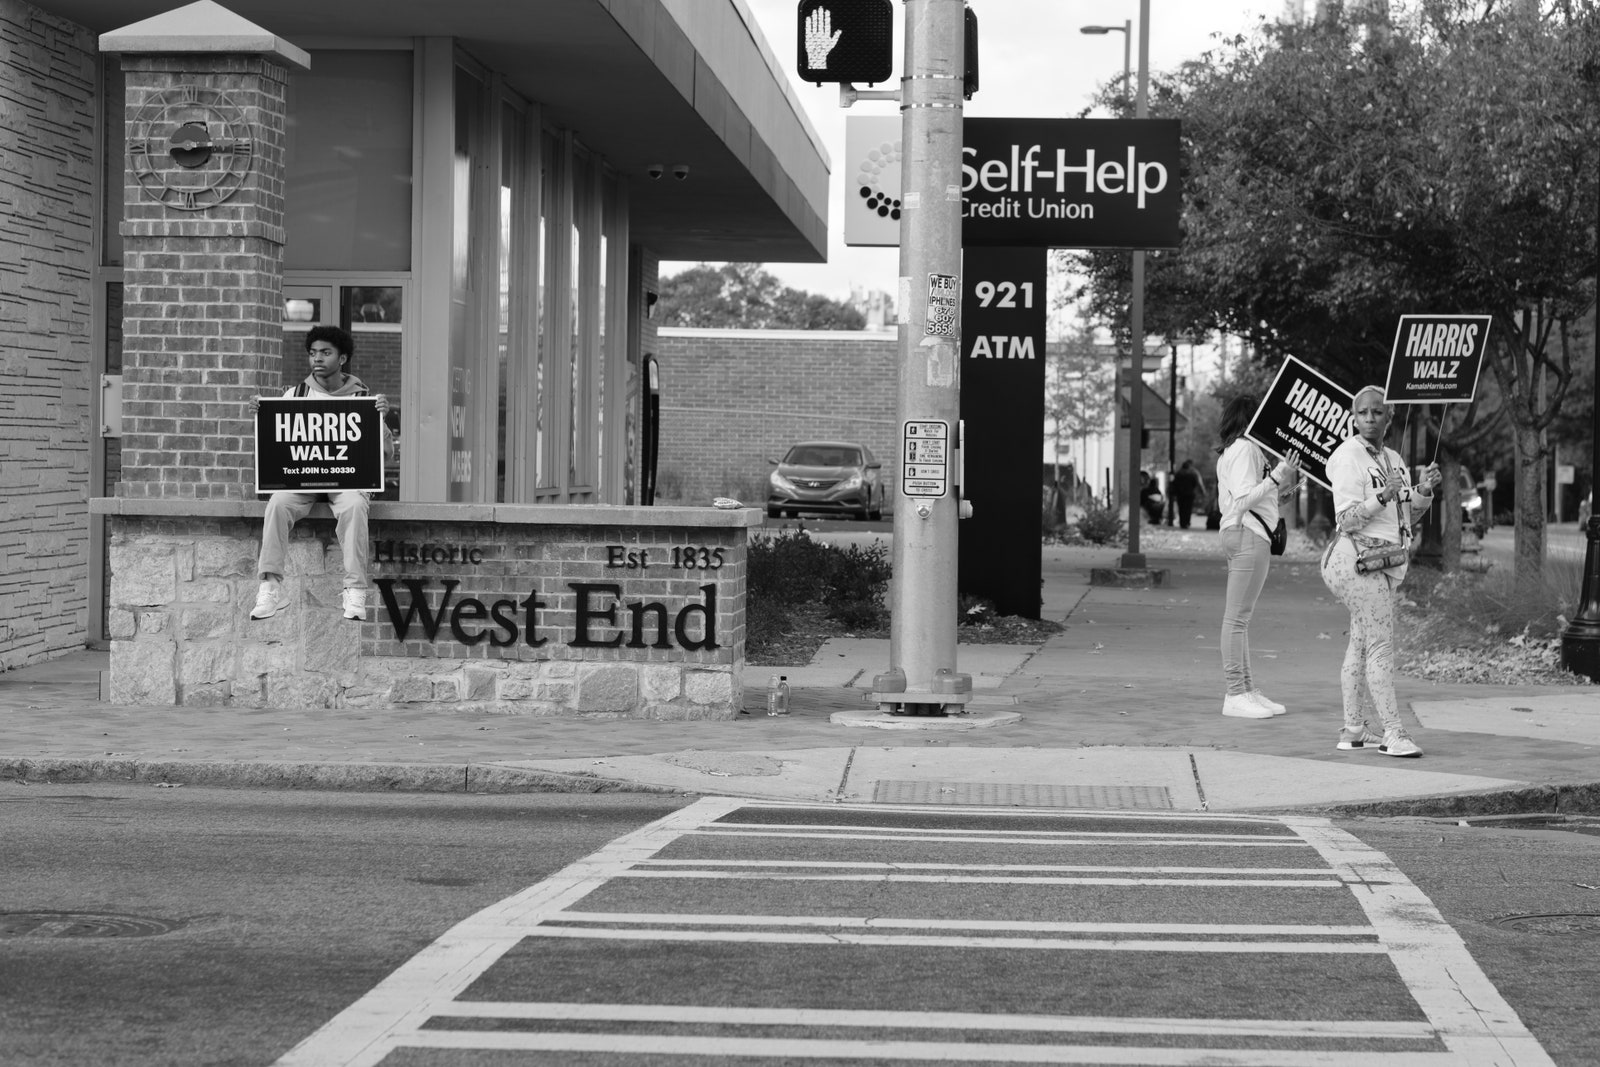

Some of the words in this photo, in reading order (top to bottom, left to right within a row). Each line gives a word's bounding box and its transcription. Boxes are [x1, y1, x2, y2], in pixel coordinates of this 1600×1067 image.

[962, 144, 1168, 209] Self-Help
[1028, 197, 1094, 219] Union
[930, 277, 942, 288] WE
[944, 278, 957, 290] BUY
[975, 281, 1034, 308] 921
[927, 321, 955, 335] 5658
[1405, 323, 1478, 357] HARRIS
[970, 335, 1036, 360] ATM
[1413, 361, 1460, 379] WALZ
[1406, 382, 1457, 390] KamalaHarris.com
[1285, 378, 1355, 441] HARRIS
[275, 411, 362, 442] HARRIS
[1288, 412, 1337, 453] WALZ
[290, 445, 348, 461] WALZ
[1275, 427, 1289, 441] Text
[1288, 436, 1305, 450] JOIN
[1303, 446, 1311, 455] to
[1310, 450, 1328, 465] 3033
[283, 467, 300, 475] Text
[330, 466, 356, 474] 30330
[373, 540, 482, 565] Historic
[606, 545, 649, 569] Est
[672, 546, 725, 570] 1835
[372, 578, 548, 649] West
[567, 583, 721, 651] End
